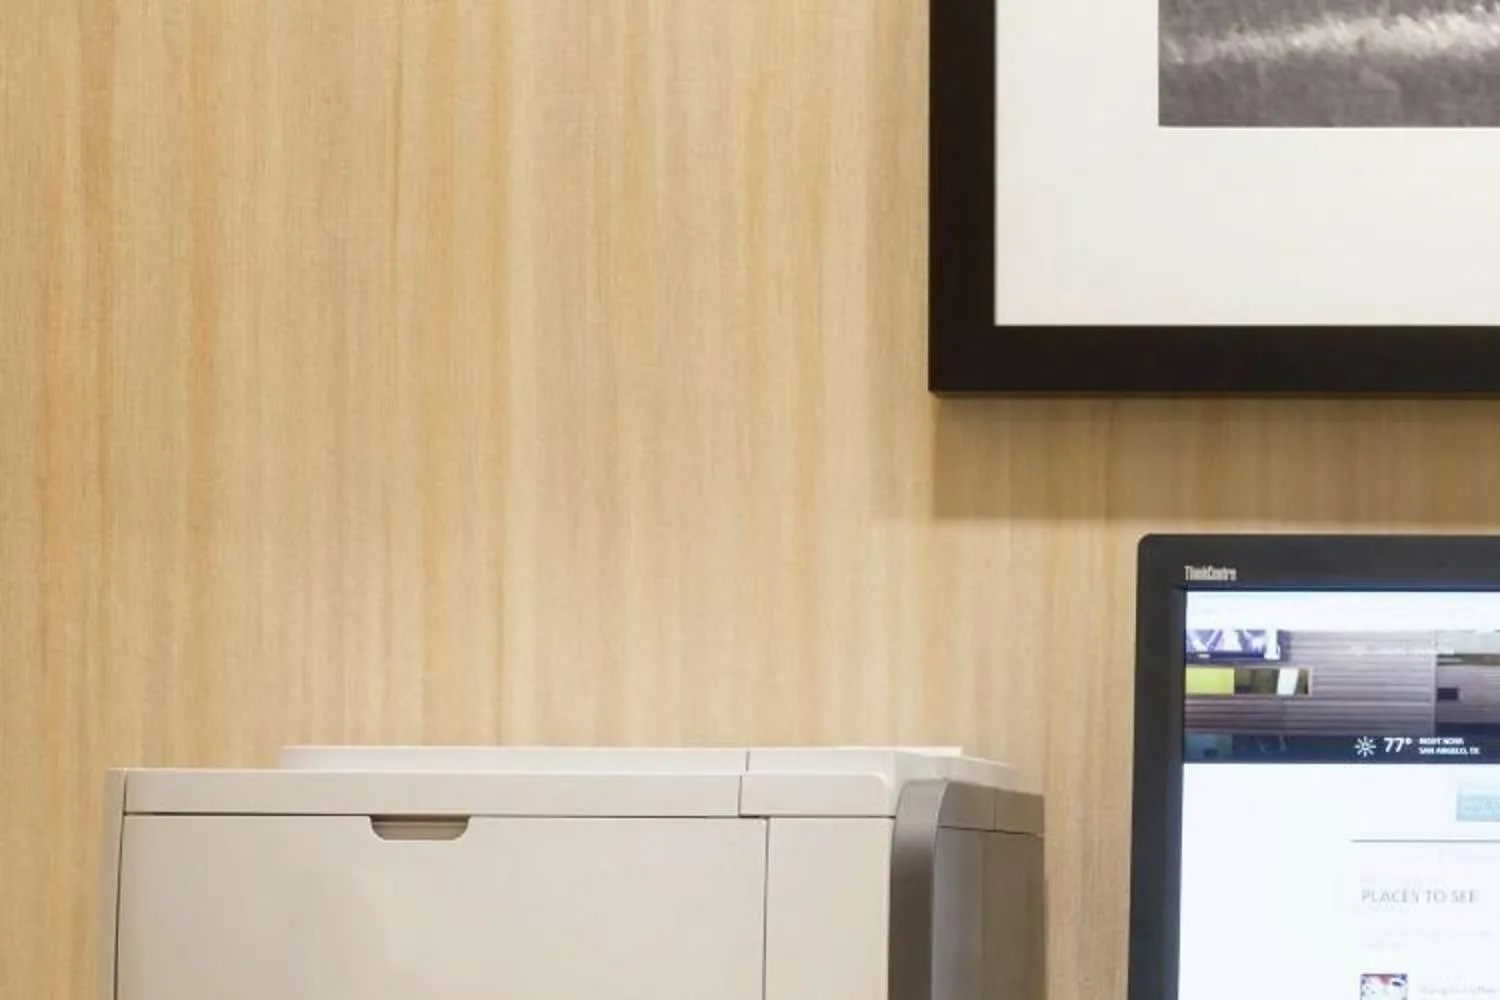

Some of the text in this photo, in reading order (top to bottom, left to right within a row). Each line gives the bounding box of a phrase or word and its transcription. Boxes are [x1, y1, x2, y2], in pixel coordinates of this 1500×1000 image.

[1361, 890, 1476, 903] PLACES TO SEE
